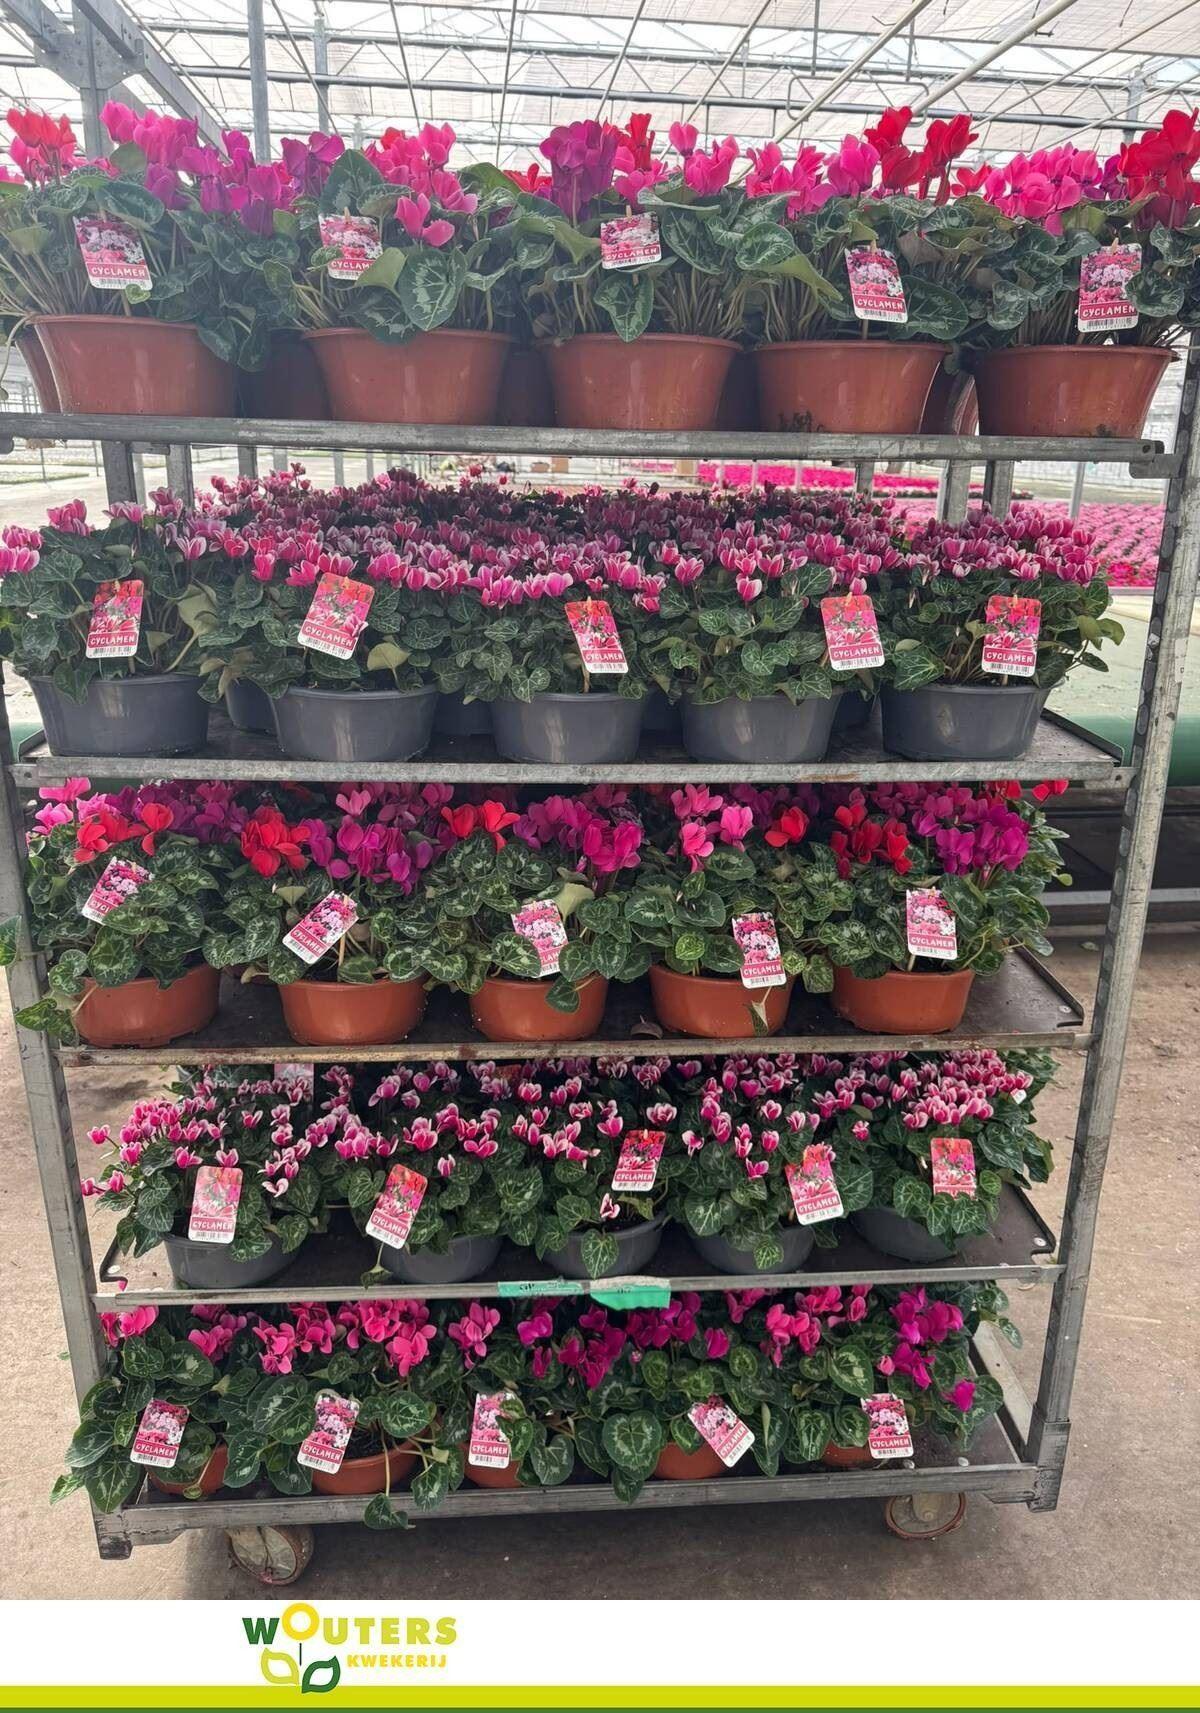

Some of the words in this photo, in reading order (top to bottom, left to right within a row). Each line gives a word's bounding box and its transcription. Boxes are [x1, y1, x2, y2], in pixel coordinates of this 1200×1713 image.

[606, 247, 657, 260] CYCLAMEN
[331, 261, 370, 269] CYCLAM
[91, 267, 145, 277] CYCLAMEN
[857, 298, 903, 310] CYCLAMEN
[1082, 305, 1135, 317] CYCLAMEN
[90, 635, 135, 645] CYCLAMEN
[305, 626, 353, 648] CYCLAMEN
[585, 652, 623, 660] CYCLAMEN
[833, 646, 879, 659] CYCLAMEN
[986, 652, 1033, 663] CYCLAMEN
[294, 930, 326, 955] CYCLAMEN
[911, 936, 954, 948] CYCLAMEN
[743, 964, 782, 976] CYCLAMEN
[616, 1173, 653, 1181] CYCLAMEN
[799, 1196, 840, 1212] CYCLAMEN
[192, 1221, 233, 1231] CYCLAMEN
[373, 1215, 407, 1236] CYCLAMEN
[720, 1425, 746, 1456] CYCLAMEN
[871, 1438, 909, 1448] CYCLAMEN
[135, 1443, 176, 1457] CYCLAMEN
[303, 1443, 341, 1460] CYCLAMEN
[472, 1445, 508, 1455] CYCLAMEN
